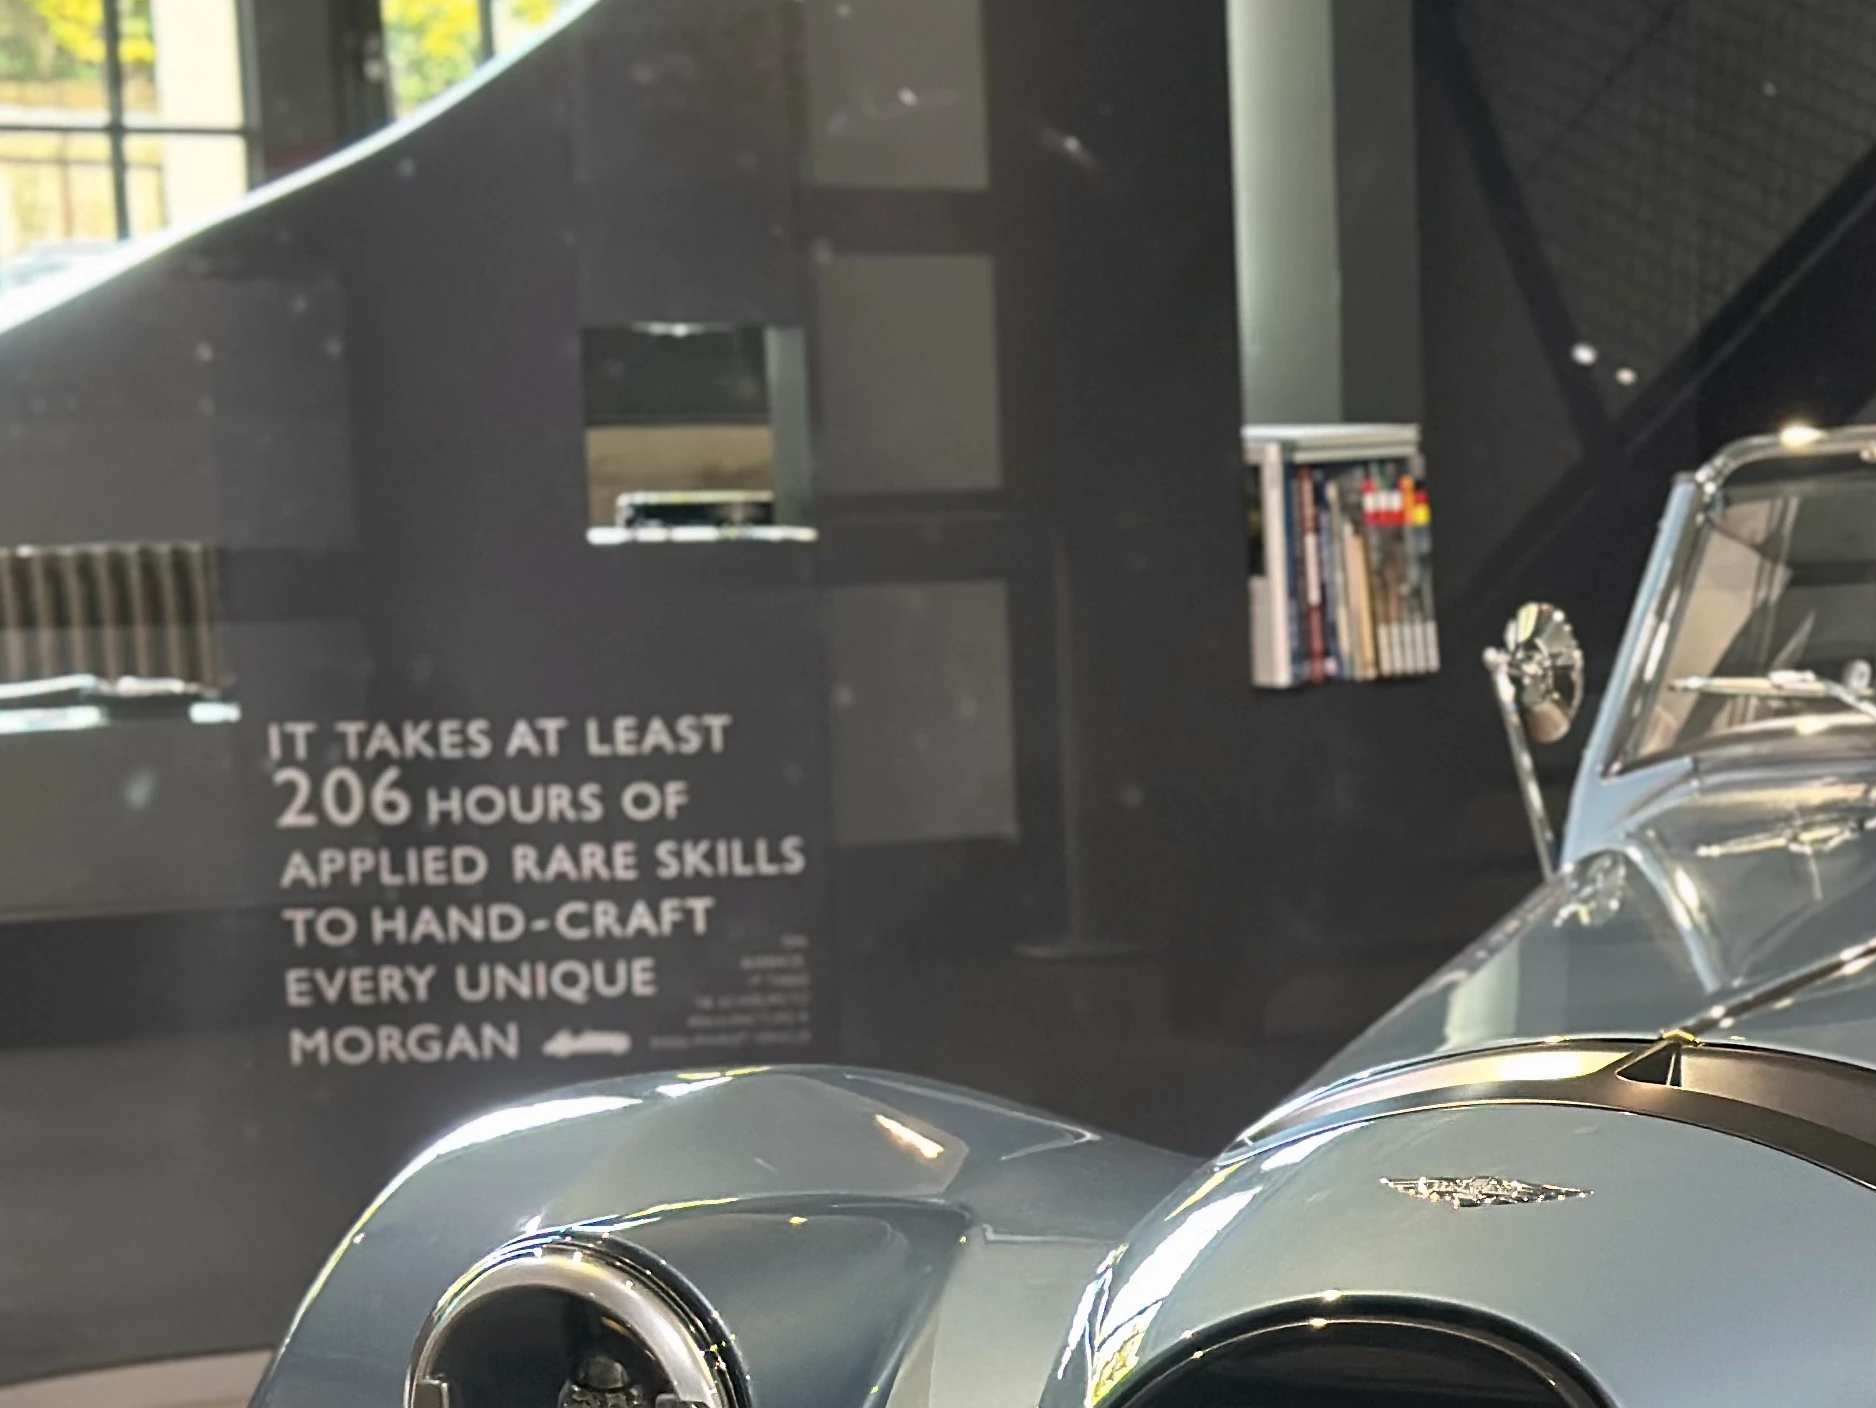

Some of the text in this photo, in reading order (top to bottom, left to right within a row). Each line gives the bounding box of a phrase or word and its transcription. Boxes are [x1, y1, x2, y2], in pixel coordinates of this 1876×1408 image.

[265, 714, 731, 760] IT TAKES AT LEAST
[272, 766, 688, 828] 206 HOURS OF
[280, 836, 805, 888] APPLIED RARE SKILLS
[282, 897, 715, 946] TO HAND-CRAFT
[286, 965, 435, 1006] EVERY
[456, 957, 657, 1004] UNIQUE
[290, 1022, 519, 1066] MORGAN
